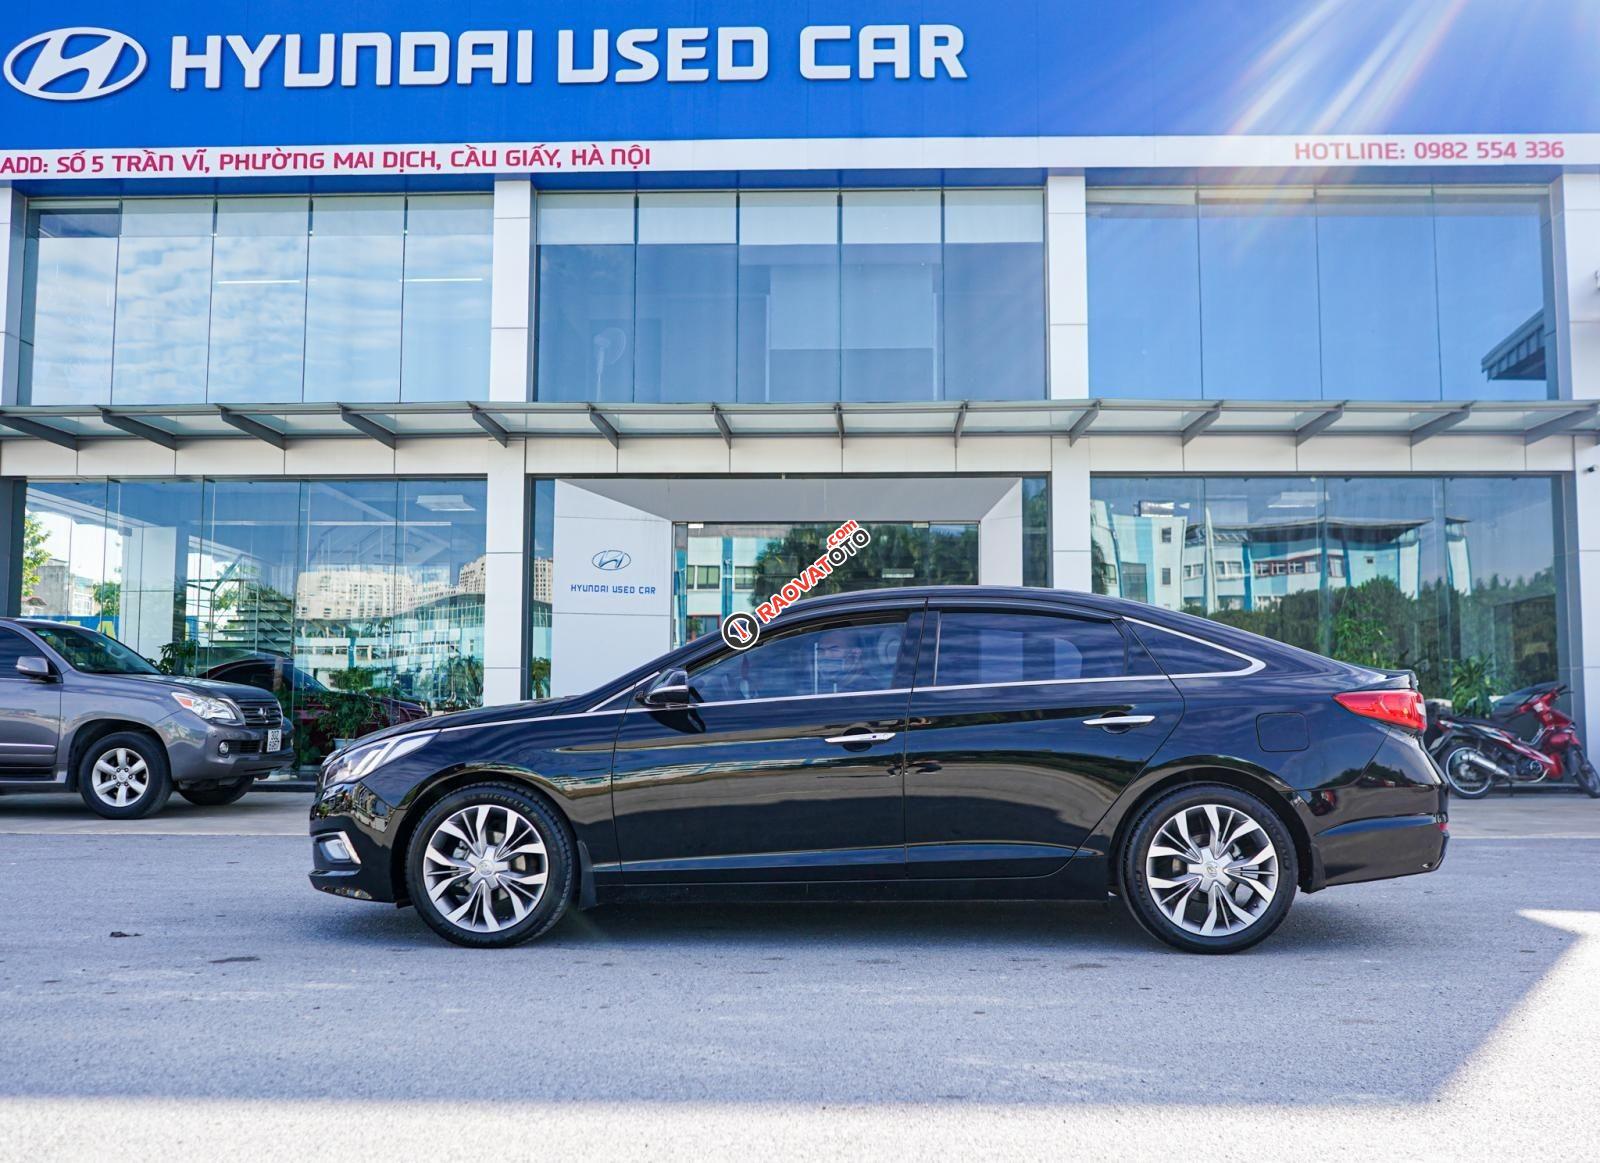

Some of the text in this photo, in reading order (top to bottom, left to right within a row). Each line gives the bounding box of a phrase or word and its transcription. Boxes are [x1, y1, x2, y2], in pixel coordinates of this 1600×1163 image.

[171, 24, 968, 90] HYUNDAI USED CAR
[0, 144, 651, 174] ADD: SỐ 5 TRẦN VĨ, PHƯỜNG MAI DỊCH, CẦU GIẤY, HÀ NỘI
[1294, 141, 1566, 160] HOTLINE: 0982 554 336
[570, 584, 656, 595] HYUNDAI USED CAR
